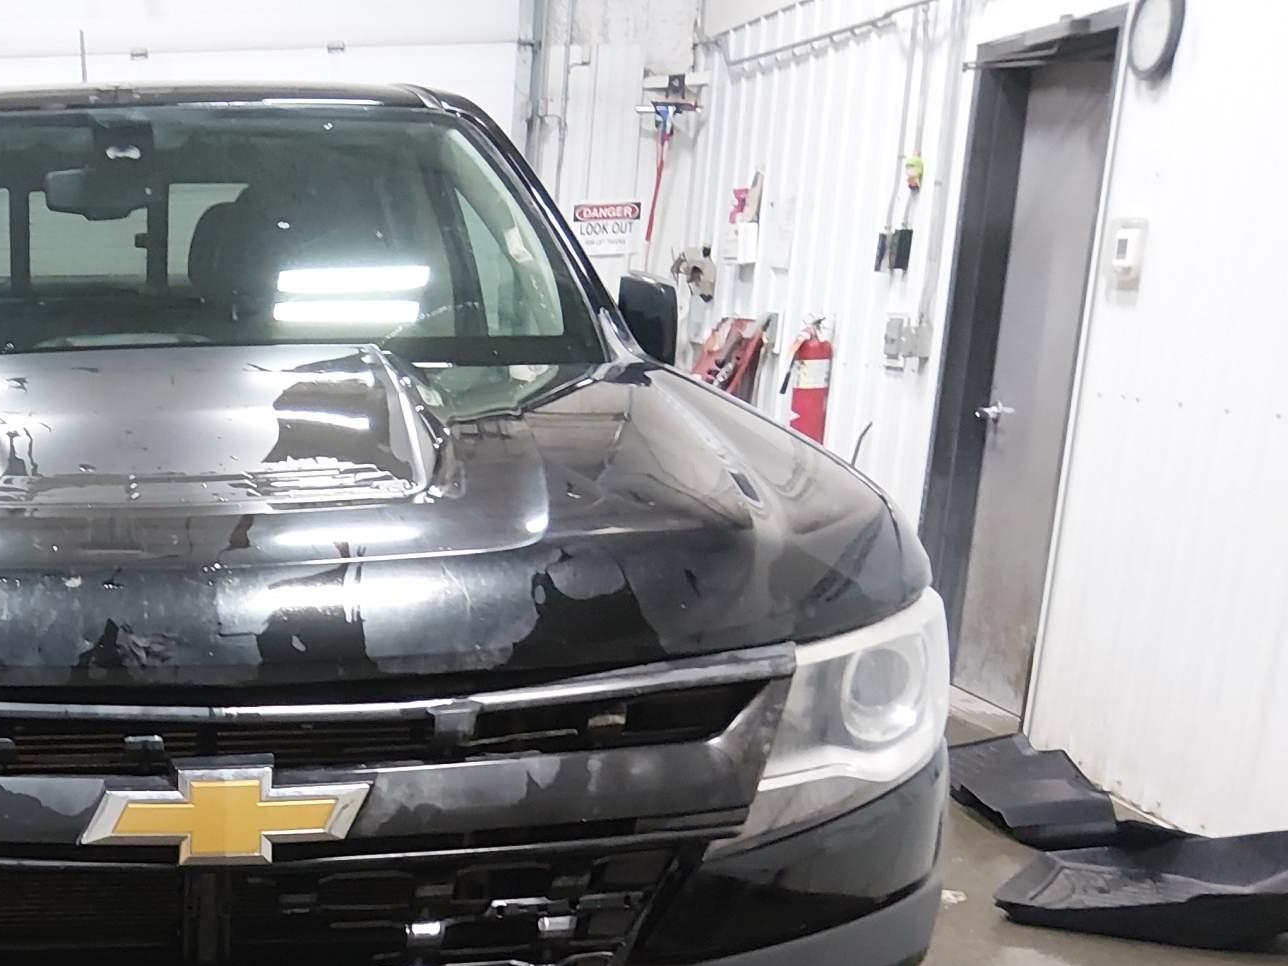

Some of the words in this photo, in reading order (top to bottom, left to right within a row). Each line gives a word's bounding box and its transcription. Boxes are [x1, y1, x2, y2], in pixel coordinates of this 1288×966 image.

[583, 206, 632, 218] DANGER
[580, 222, 608, 236] LOOK
[612, 221, 633, 234] OUT
